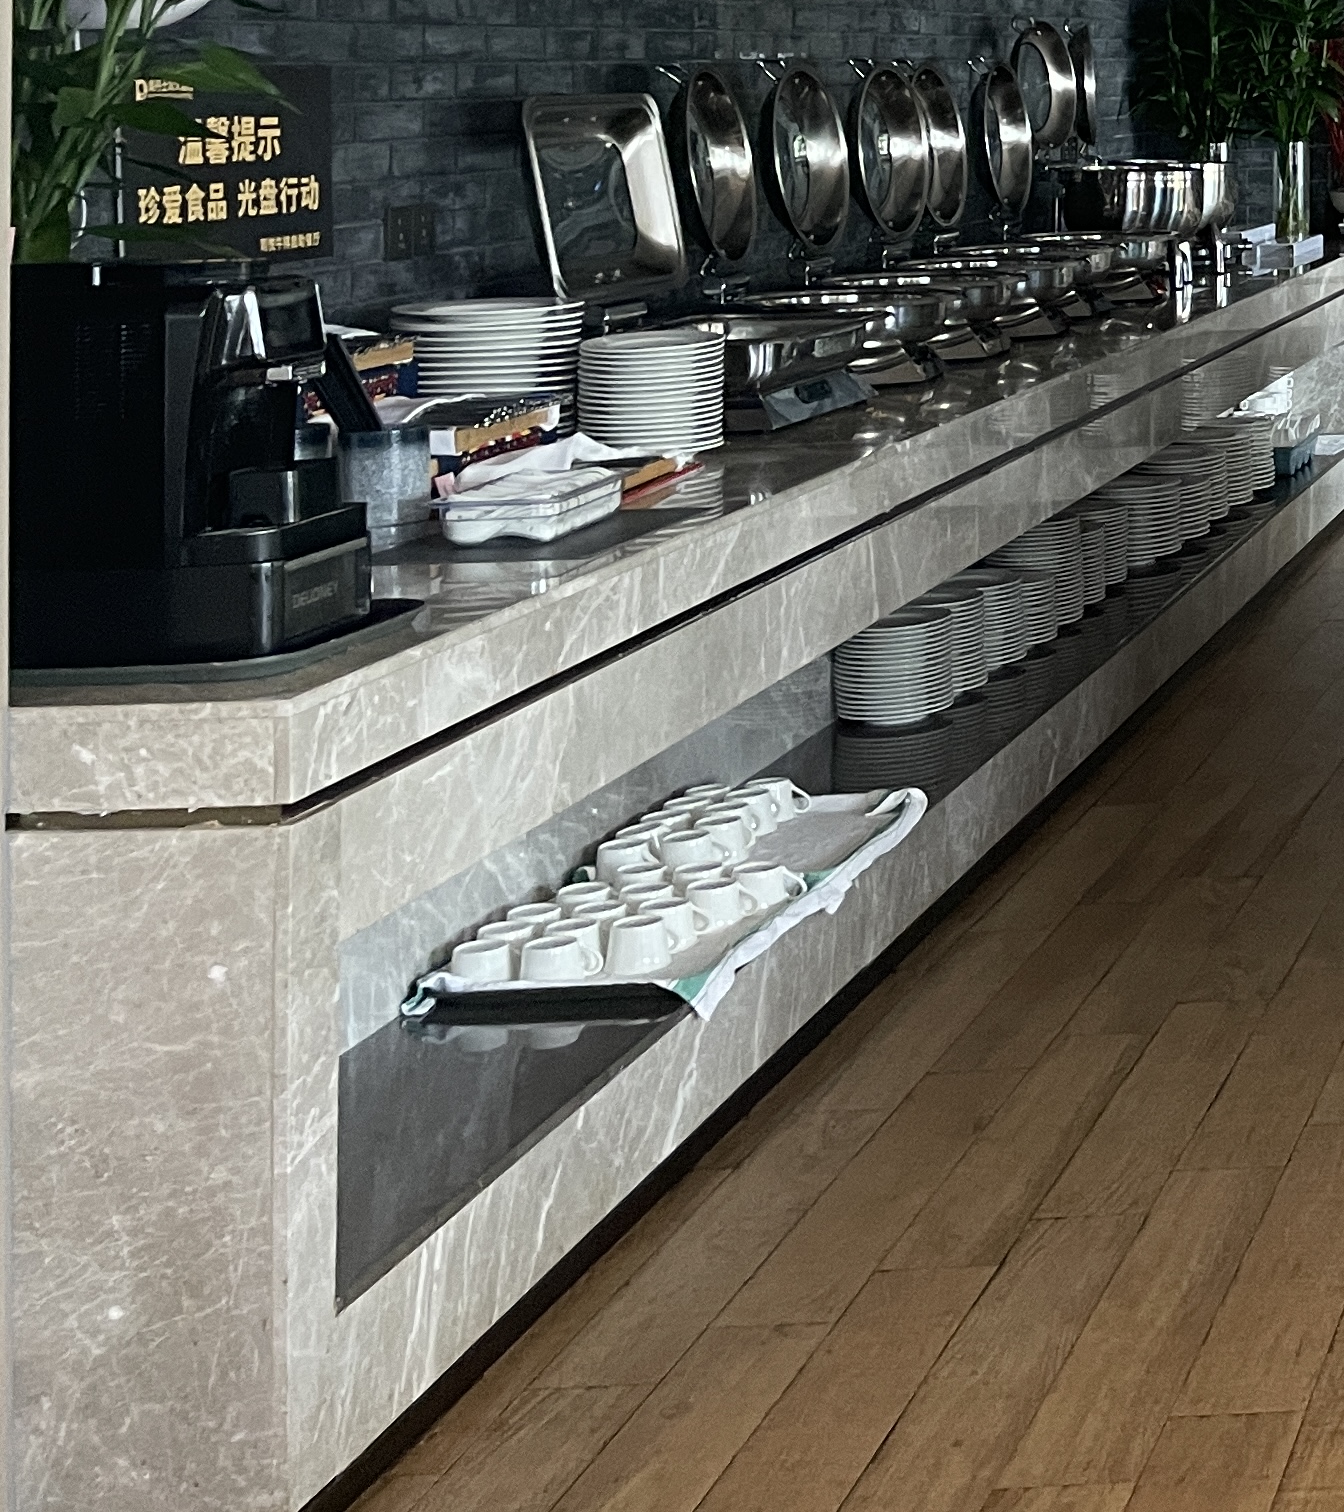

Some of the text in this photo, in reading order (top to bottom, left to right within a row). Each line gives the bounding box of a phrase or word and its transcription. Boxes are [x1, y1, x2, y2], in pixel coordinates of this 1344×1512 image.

[137, 174, 320, 225] 珍爱食品 光盘行动
